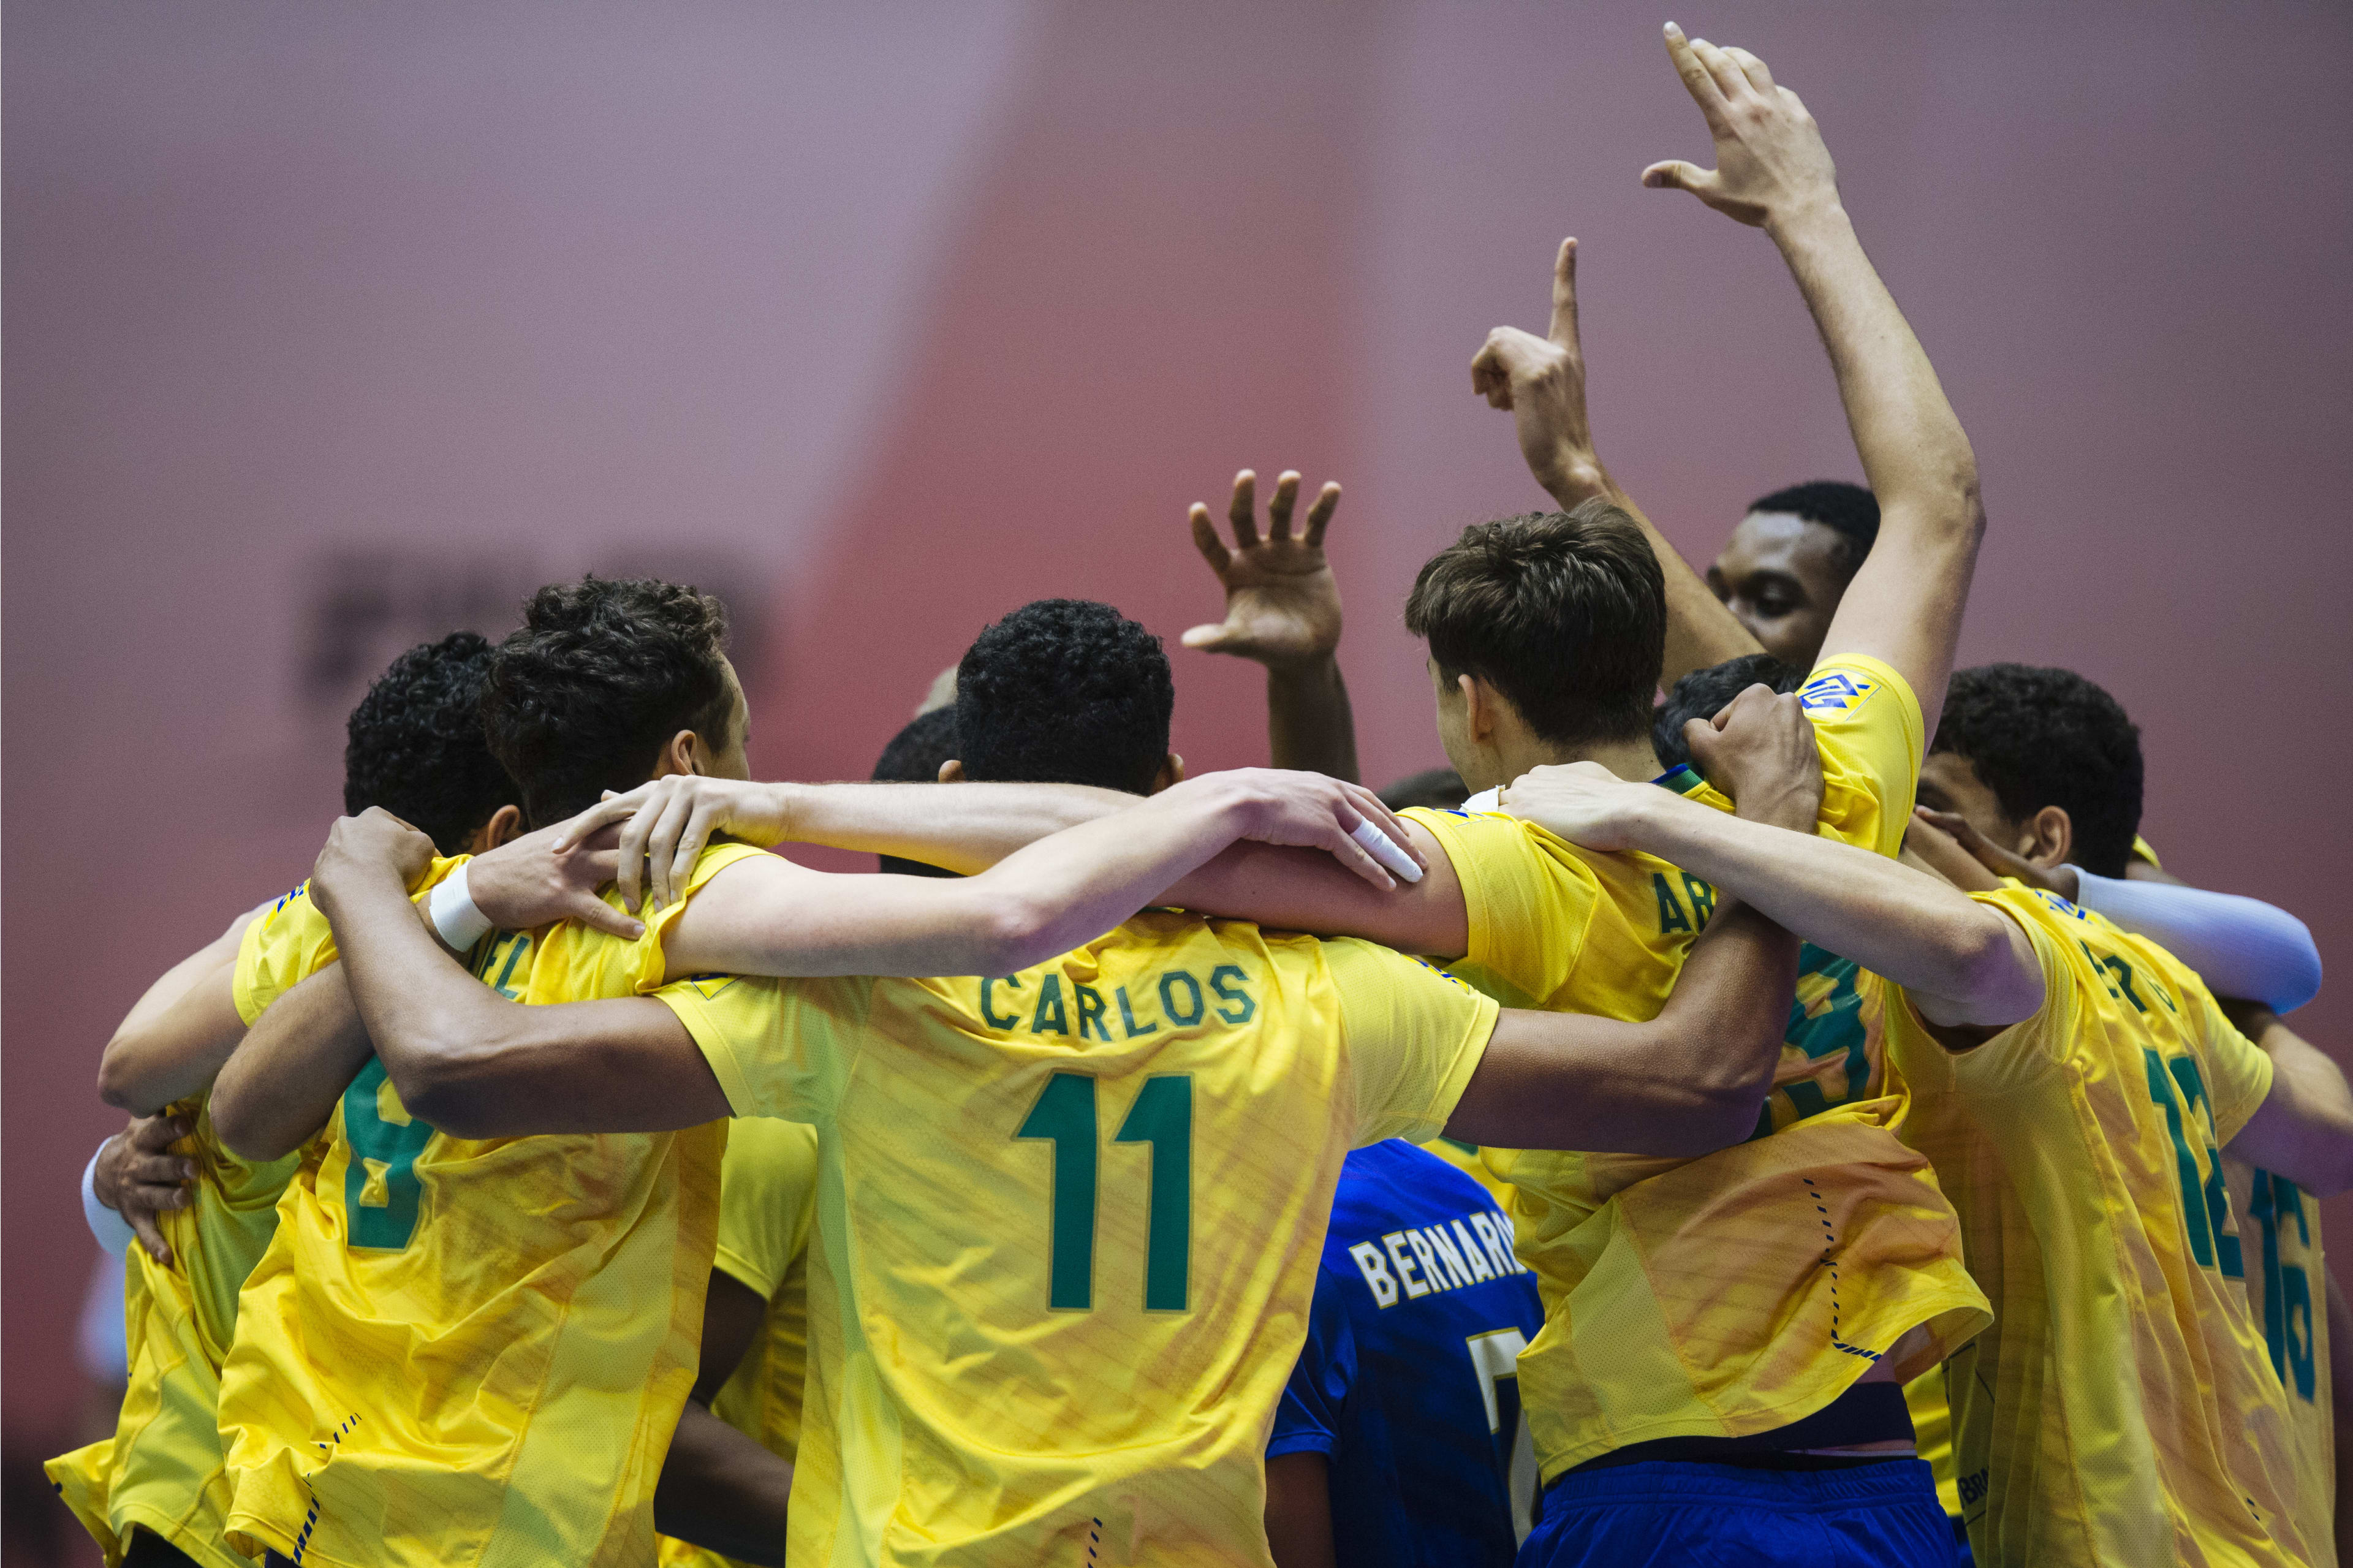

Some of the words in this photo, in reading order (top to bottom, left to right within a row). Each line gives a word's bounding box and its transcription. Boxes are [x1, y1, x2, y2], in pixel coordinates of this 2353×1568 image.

[979, 964, 1257, 1042] CARLOS
[1010, 1068, 1195, 1314] 11
[2145, 1045, 2246, 1282] 12
[2249, 1165, 2316, 1404] 16
